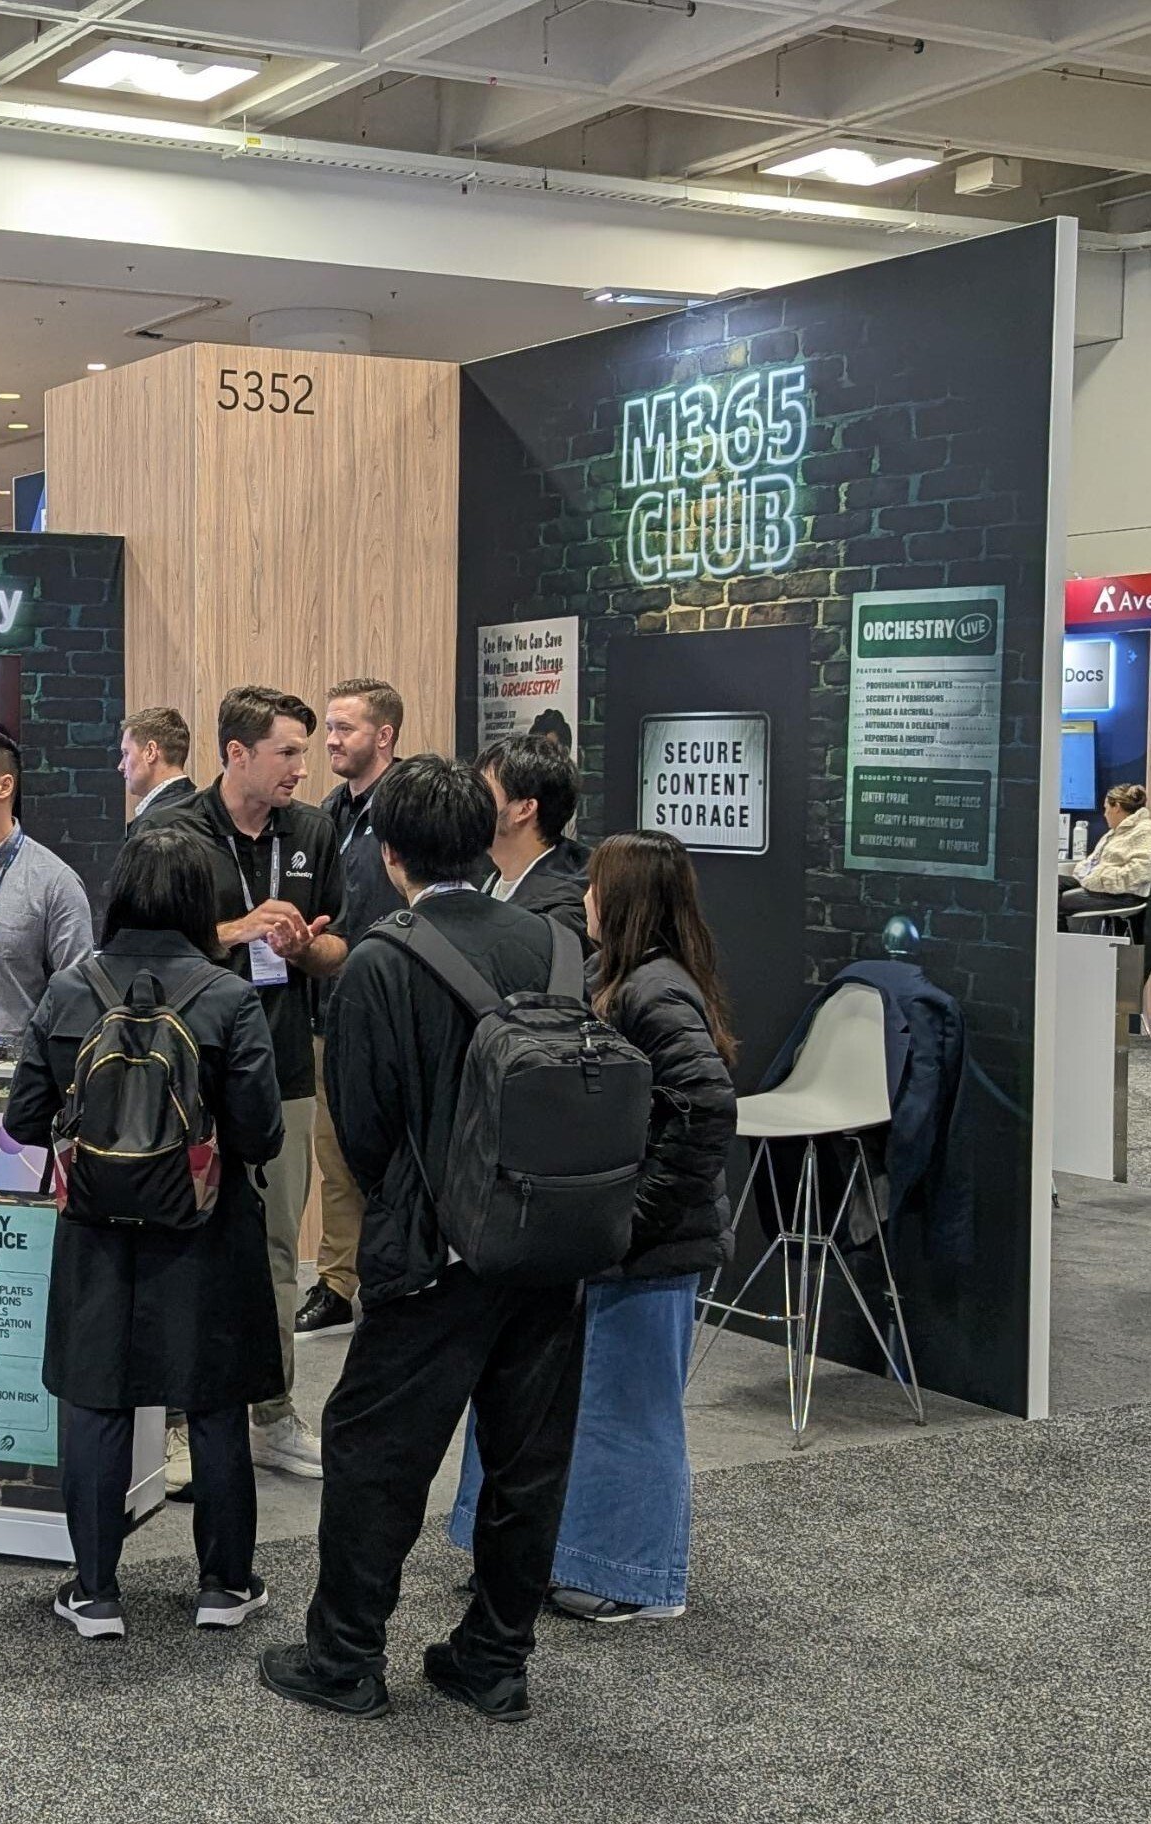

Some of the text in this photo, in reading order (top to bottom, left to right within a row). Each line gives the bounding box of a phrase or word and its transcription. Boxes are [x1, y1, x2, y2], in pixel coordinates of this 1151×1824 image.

[218, 369, 315, 415] 5352
[621, 365, 807, 488] M365
[628, 473, 798, 584] CLUB
[863, 619, 986, 641] ORCHESTRY LIVE
[483, 631, 562, 654] See How You Can Save
[484, 654, 563, 675] More Time and Storage
[916, 681, 953, 690] TEMPLATES
[1065, 668, 1104, 683] Docs
[483, 679, 560, 698] With ORCHESTRY!
[865, 694, 894, 703] SECURITY
[865, 708, 892, 716] STORAGE
[899, 708, 934, 716] ARCHIVALS
[864, 721, 905, 730] AUTOMATION
[911, 721, 950, 730] DELEGATION
[864, 734, 898, 743] REPORTING
[905, 735, 935, 744] INSIGHTS
[664, 741, 742, 764] SECURE
[657, 773, 749, 796] CONTENT
[656, 803, 749, 828] STORAGE
[17, 1392, 39, 1403] RISK
